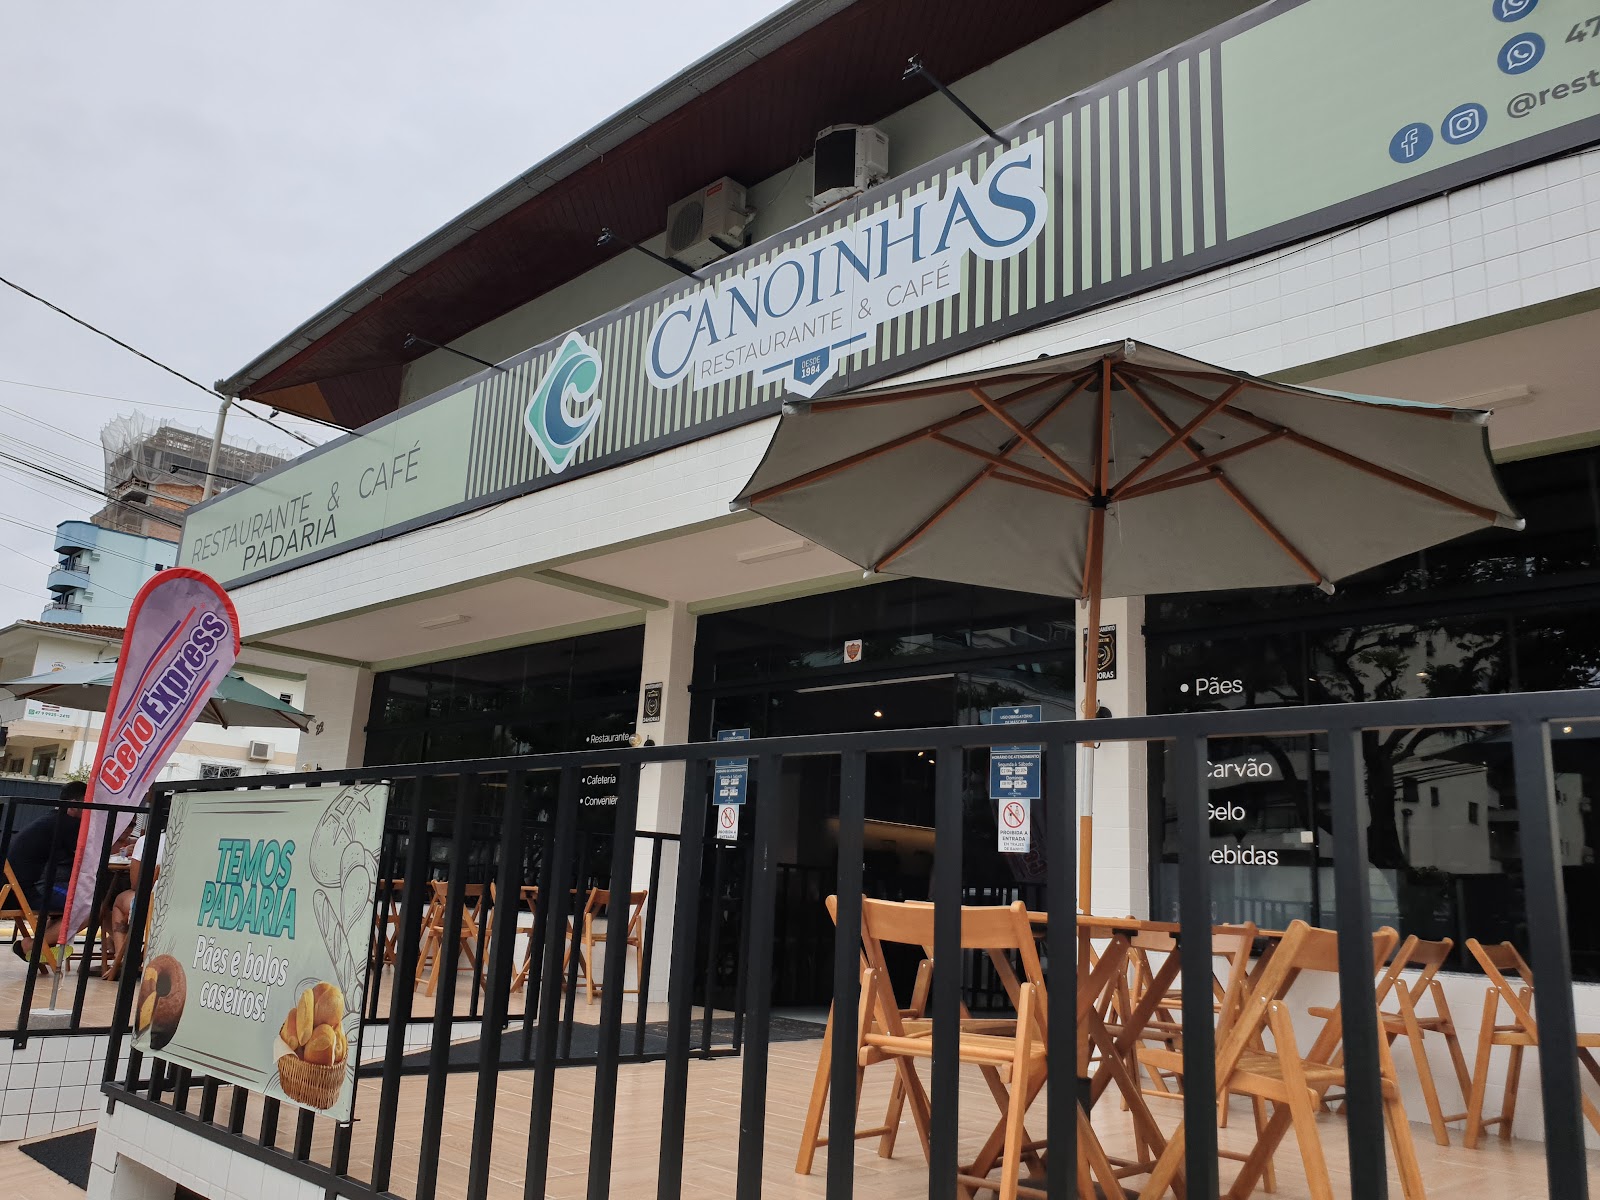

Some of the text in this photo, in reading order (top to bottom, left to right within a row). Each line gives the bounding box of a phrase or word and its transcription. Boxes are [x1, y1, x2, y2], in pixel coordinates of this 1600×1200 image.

[652, 154, 1036, 380] CANOINHAS
[701, 260, 950, 380] RESTAURANTE & CAFÉ
[801, 355, 820, 369] DESDE
[801, 363, 820, 378] 1984
[192, 440, 421, 564] RESTAURANTE & CAFÉ
[242, 514, 337, 571] PADARIA
[1195, 677, 1243, 696] Pães
[590, 732, 629, 743] Restaurante
[586, 774, 616, 785] Cafeteria
[216, 838, 296, 888] TEMOS
[1209, 845, 1279, 865] ebidas
[197, 881, 296, 939] PADARIA
[192, 935, 289, 987] Pães e bolos
[200, 978, 271, 1022] caseiros!
